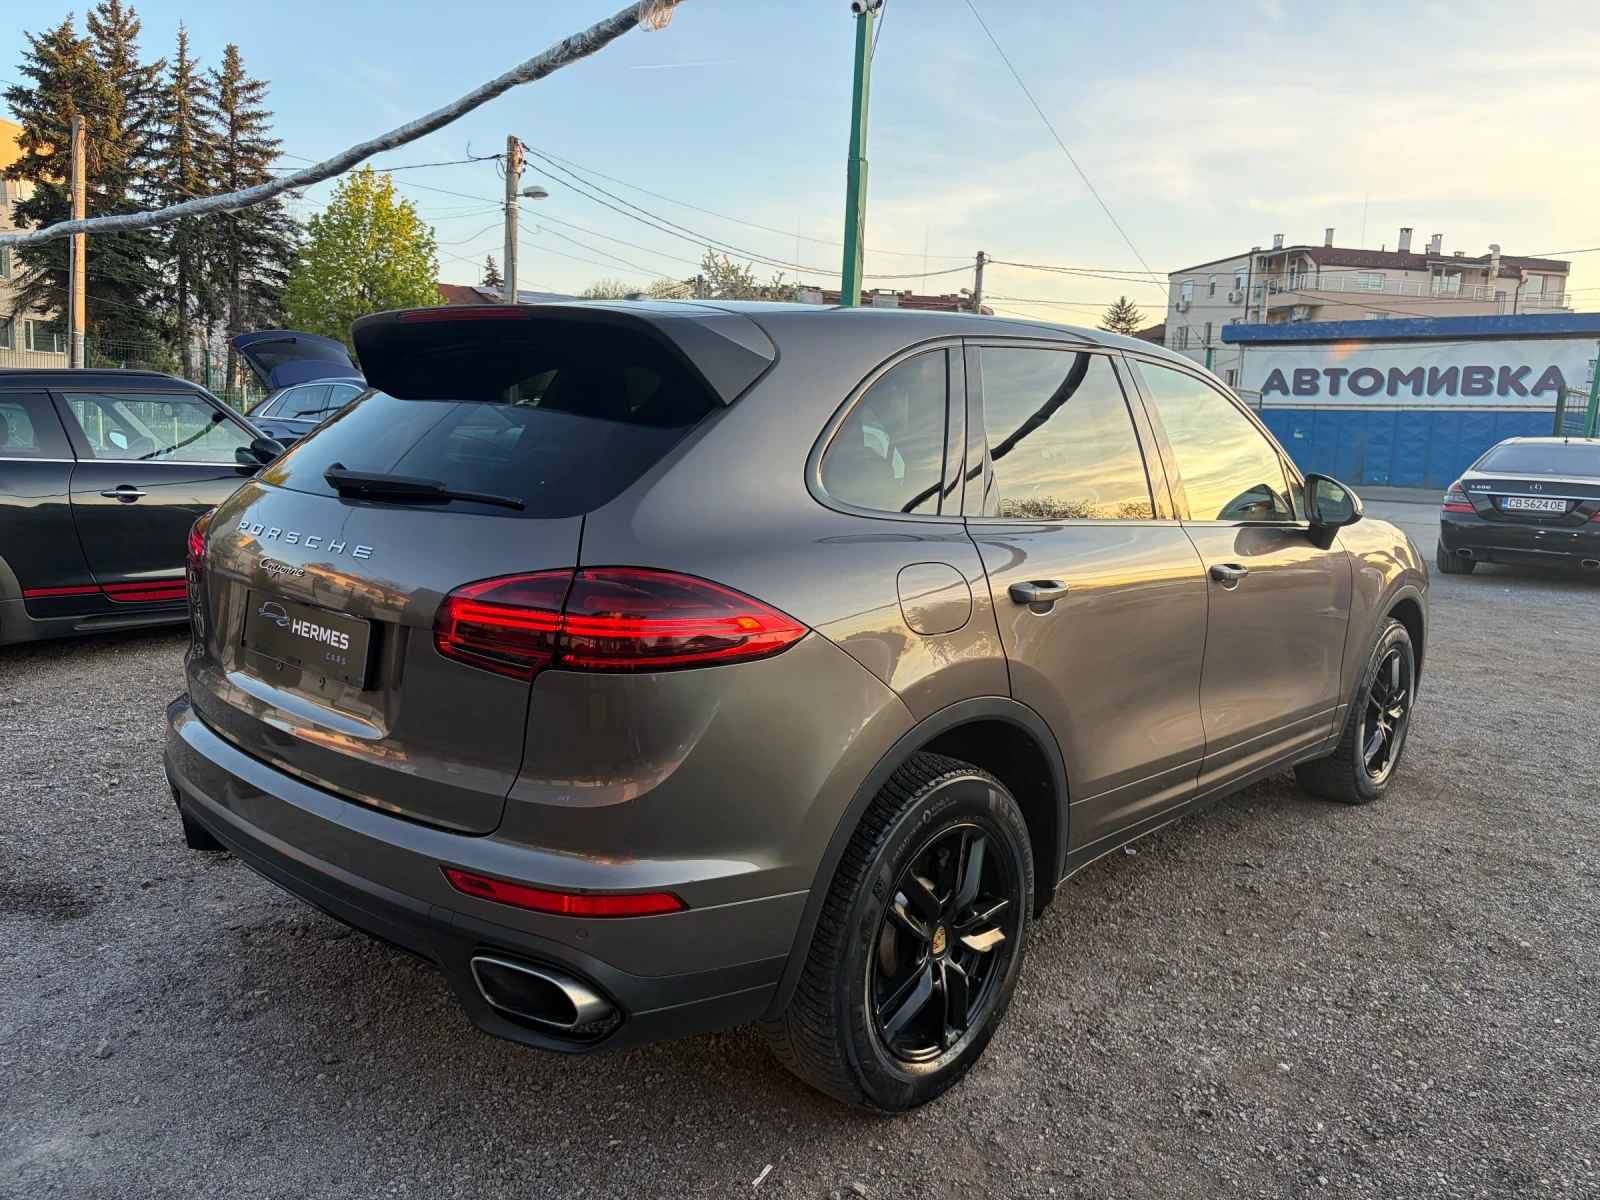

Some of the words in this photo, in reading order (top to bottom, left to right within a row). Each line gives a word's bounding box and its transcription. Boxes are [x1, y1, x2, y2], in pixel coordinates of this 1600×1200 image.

[1263, 364, 1566, 397] АВТОМИВКА
[1509, 499, 1523, 508] CB
[1523, 499, 1549, 509] 5624
[238, 520, 374, 559] PORSCHE
[259, 557, 305, 578] Cayenne
[291, 618, 350, 650] HERMES
[325, 652, 346, 665] CARS
